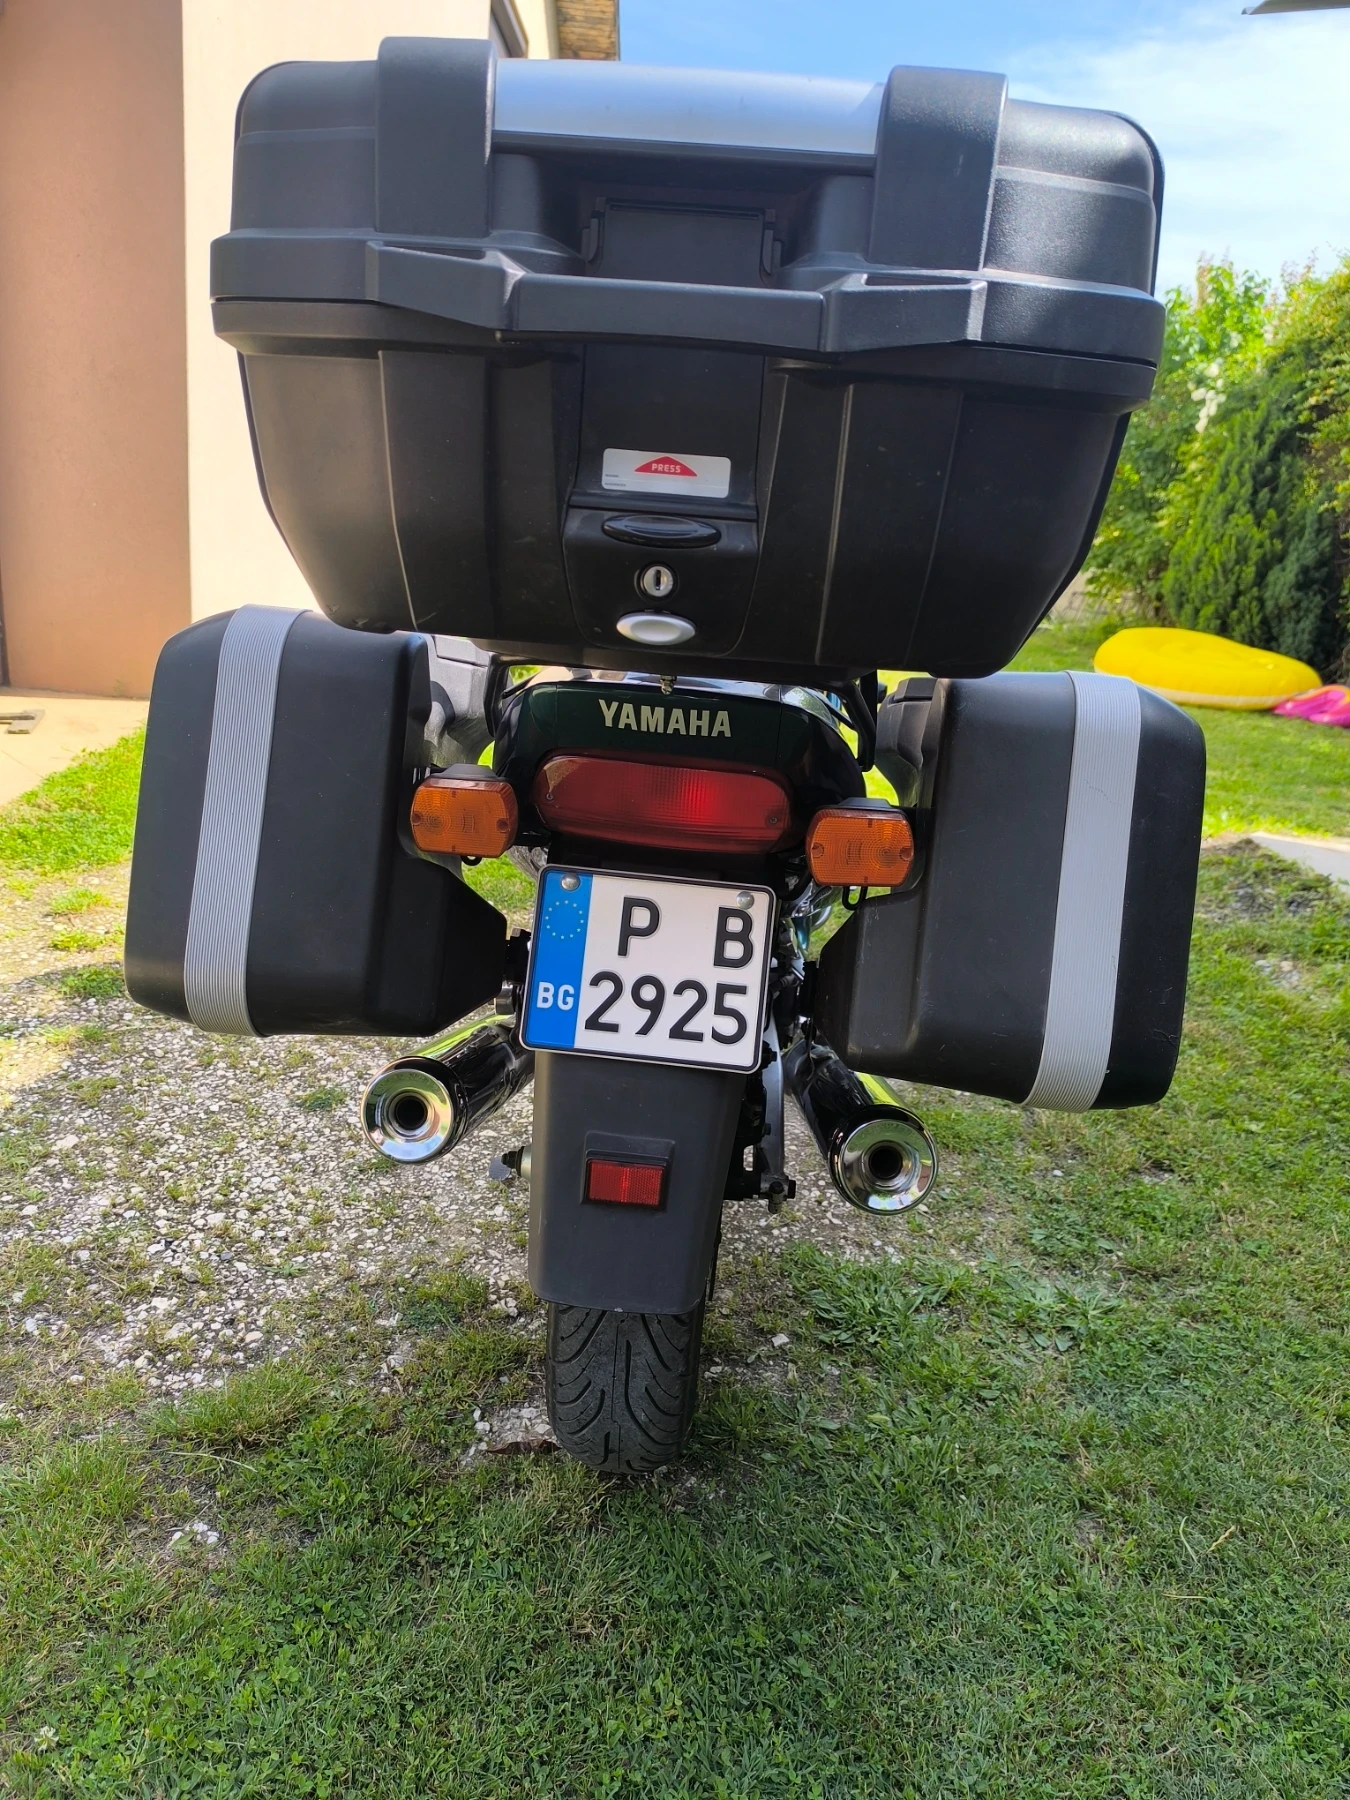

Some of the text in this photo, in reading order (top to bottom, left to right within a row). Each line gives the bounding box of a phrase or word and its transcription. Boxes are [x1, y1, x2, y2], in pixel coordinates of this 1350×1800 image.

[651, 463, 681, 473] PRESS
[598, 699, 732, 737] YAMAHA
[617, 896, 754, 968] P B
[536, 981, 575, 1011] BG
[584, 970, 748, 1045] 2925
